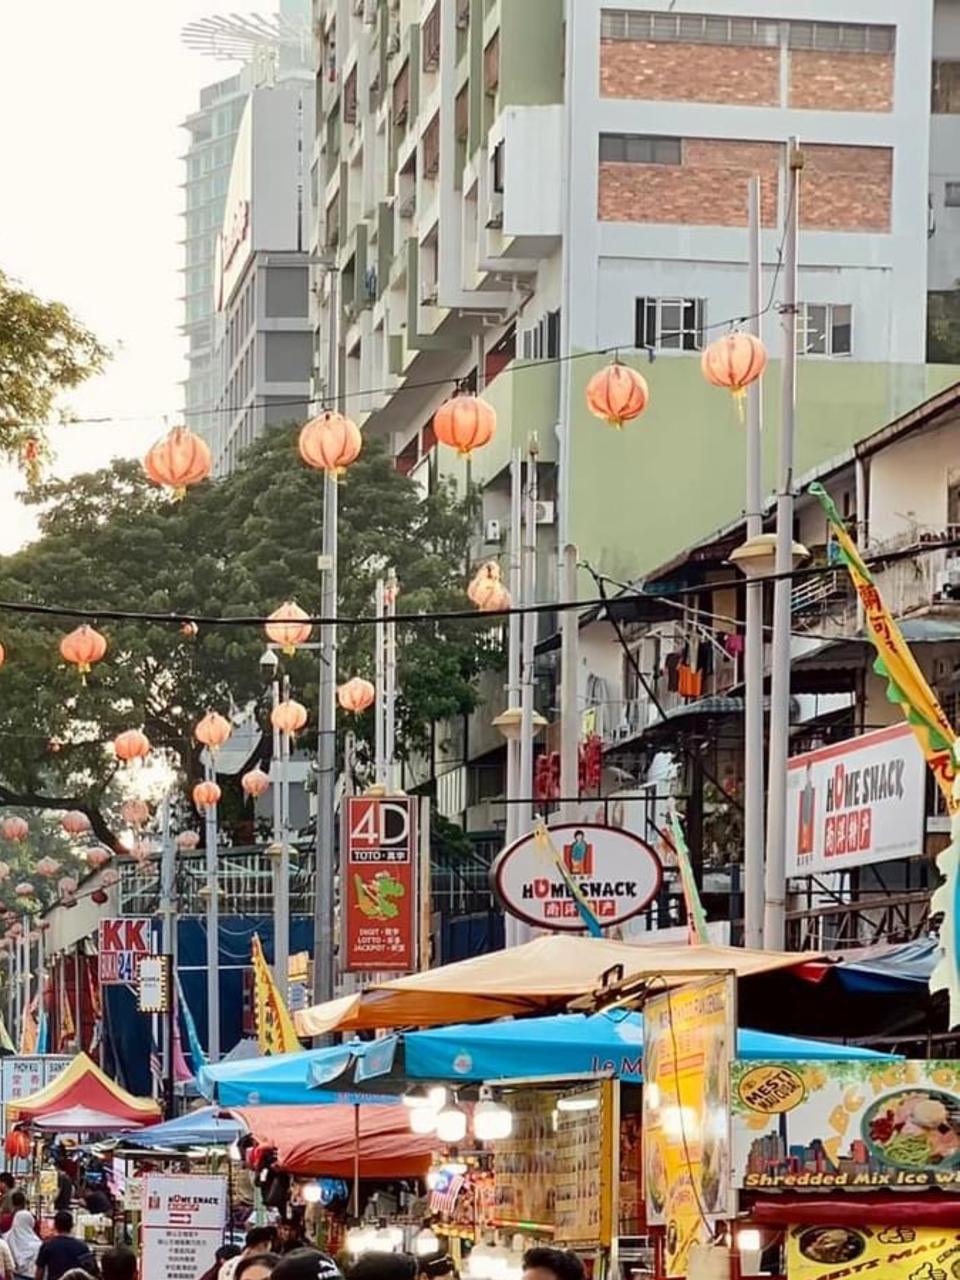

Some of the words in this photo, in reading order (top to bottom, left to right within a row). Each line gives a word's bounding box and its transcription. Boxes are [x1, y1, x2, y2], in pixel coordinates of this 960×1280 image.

[826, 763, 860, 812] HOME
[862, 759, 905, 804] SNACK
[351, 802, 409, 845] 4D
[355, 852, 381, 860] TOTO
[578, 882, 637, 898] SNACK
[545, 901, 616, 918] 南洋产
[103, 919, 147, 951] KK
[622, 1057, 642, 1075] M
[746, 1172, 848, 1186] Shredded
[853, 1172, 890, 1185] Mix
[897, 1170, 930, 1184] Ice
[934, 1170, 960, 1184] wi
